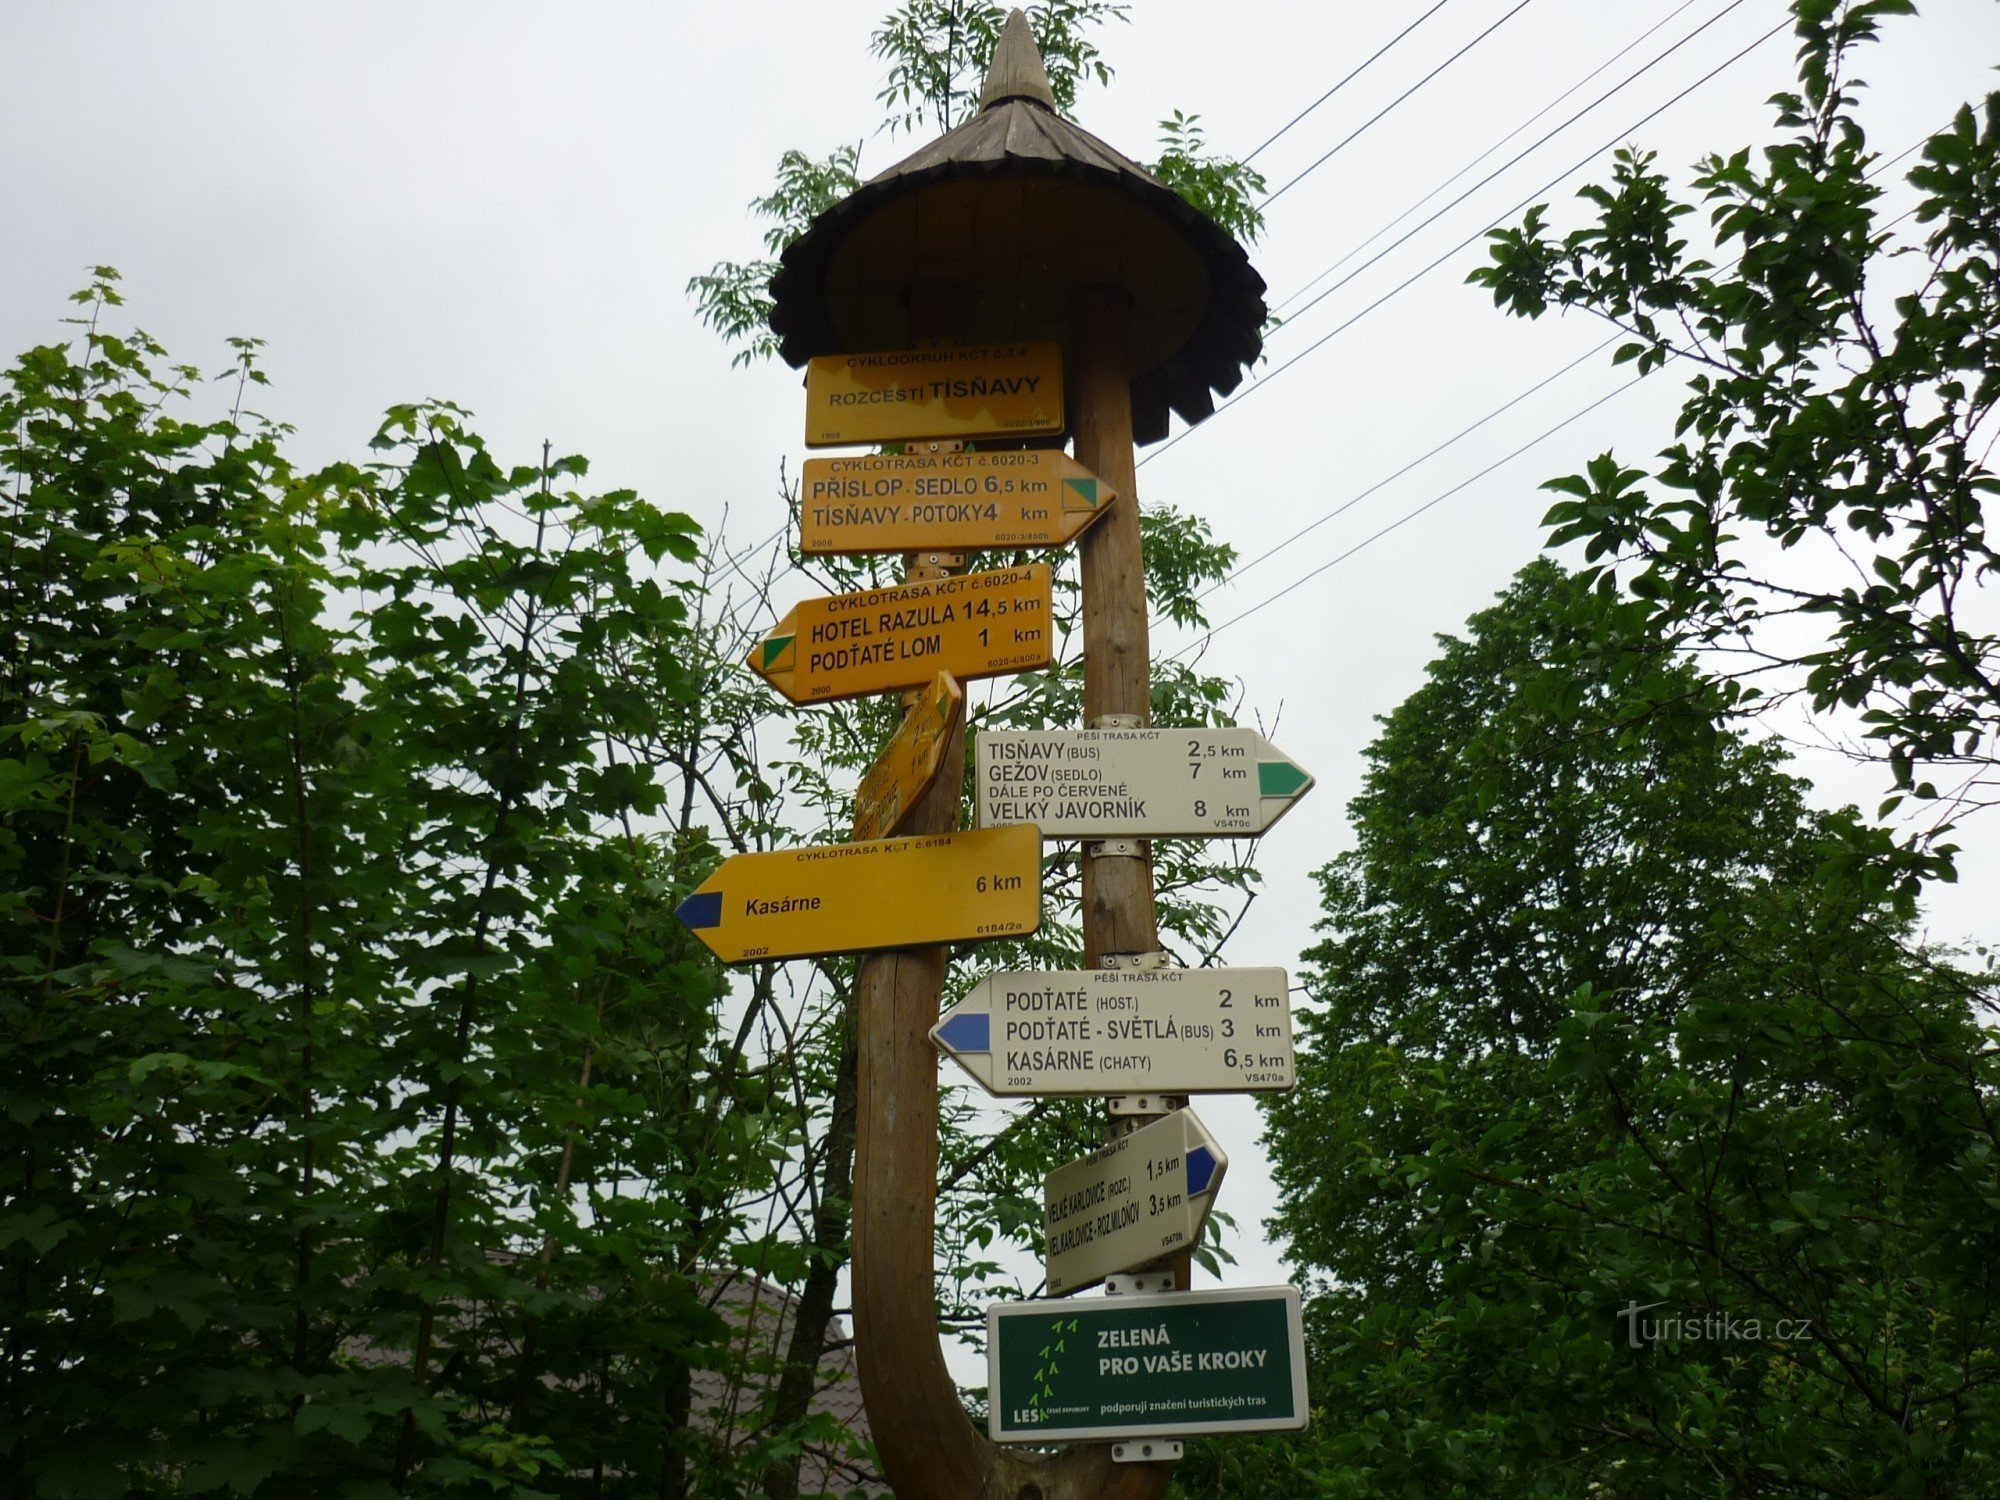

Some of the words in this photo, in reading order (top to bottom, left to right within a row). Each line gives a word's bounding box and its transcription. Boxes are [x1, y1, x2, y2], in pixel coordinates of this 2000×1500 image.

[847, 351, 954, 368] CYKLOOKRUH
[830, 385, 924, 406] ROZCESTÍ
[928, 376, 1041, 399] TÍSŇAVY
[831, 457, 938, 472] CYKLOTRASA
[943, 456, 973, 468] KČT
[978, 454, 1040, 467] č.6020-3
[813, 476, 903, 499] PŘÍSLOP
[915, 477, 978, 496] SEDLO
[984, 475, 1015, 495] 6,5
[1020, 480, 1048, 493] km
[813, 503, 901, 527] TÍSŇAVY
[913, 503, 983, 523] POTOKY
[1021, 507, 1049, 520] km
[828, 586, 931, 612] CYKLOTRASA
[936, 580, 966, 595] KČT
[971, 570, 1032, 590] č.6020-4
[812, 617, 873, 643] HOTEL
[879, 604, 955, 633] RAZULA
[963, 598, 1008, 620] 14,5
[1014, 598, 1041, 612] km
[811, 637, 894, 673] PODŤATÉ
[901, 635, 940, 659] LOM
[978, 628, 988, 648] 1
[1014, 628, 1041, 643] km
[1077, 732, 1100, 741] PĚŠÍ
[1103, 732, 1137, 741] TRASA
[1140, 731, 1160, 740] KČT
[988, 739, 1065, 760] TISŇAVY
[1067, 747, 1100, 762] (BUS)
[1187, 741, 1216, 759] 2,5
[1221, 745, 1245, 757] km
[989, 760, 1049, 782] GEŽOV
[1051, 769, 1102, 784] (SEDLO)
[1189, 762, 1201, 779] 7
[1223, 767, 1247, 779] km
[989, 782, 1029, 798] DÁLE
[1033, 785, 1054, 798] PO
[1058, 782, 1128, 797] ČERVENÉ
[989, 798, 1049, 820] VELKÝ
[1055, 796, 1147, 819] JAVORNÍK
[1194, 800, 1207, 818] 8
[1226, 805, 1250, 817] km
[1214, 819, 1251, 828] VS470c
[797, 845, 879, 862] CYKLOTRASA
[745, 895, 821, 916] Kasárne
[976, 876, 987, 893] 6
[993, 874, 1022, 891] km
[976, 922, 1022, 934] 6184/2a
[742, 946, 769, 957] 2002
[1094, 972, 1119, 983] PĚŠÍ
[1122, 973, 1159, 982] TRASA
[1162, 972, 1183, 982] KČT
[1006, 986, 1088, 1011] PODŤATÉ
[1096, 996, 1139, 1013] (HOST.)
[1218, 989, 1233, 1008] 2
[1254, 995, 1280, 1008] km
[1006, 1016, 1091, 1041] PODŤATÉ
[1107, 1014, 1178, 1039] SVĚTLÁ
[1180, 1024, 1214, 1041] (BUS)
[1221, 1019, 1235, 1038] 3
[1256, 1024, 1281, 1037] km
[1007, 1046, 1094, 1071] KASÁRNE
[1099, 1055, 1152, 1073] (CHATY)
[1224, 1048, 1253, 1070] 6,5
[1259, 1054, 1284, 1067] km
[1007, 1077, 1032, 1086] 2002
[1245, 1073, 1284, 1082] VS470a
[1048, 1193, 1068, 1225] VELKÉ
[1068, 1181, 1105, 1215] KARLOVICE
[1147, 1160, 1163, 1181] 1,5
[1165, 1157, 1180, 1173] km
[1149, 1194, 1165, 1217] 3,5
[1167, 1193, 1181, 1210] km
[1097, 1323, 1171, 1349] ZELENÁ
[1099, 1357, 1139, 1376] PRO
[1143, 1350, 1193, 1374] VAŠE
[1198, 1349, 1267, 1371] KROKY
[1100, 1400, 1148, 1416] podporují
[1149, 1399, 1186, 1411] značení
[1189, 1396, 1245, 1410] turistických
[1247, 1396, 1266, 1406] tras
